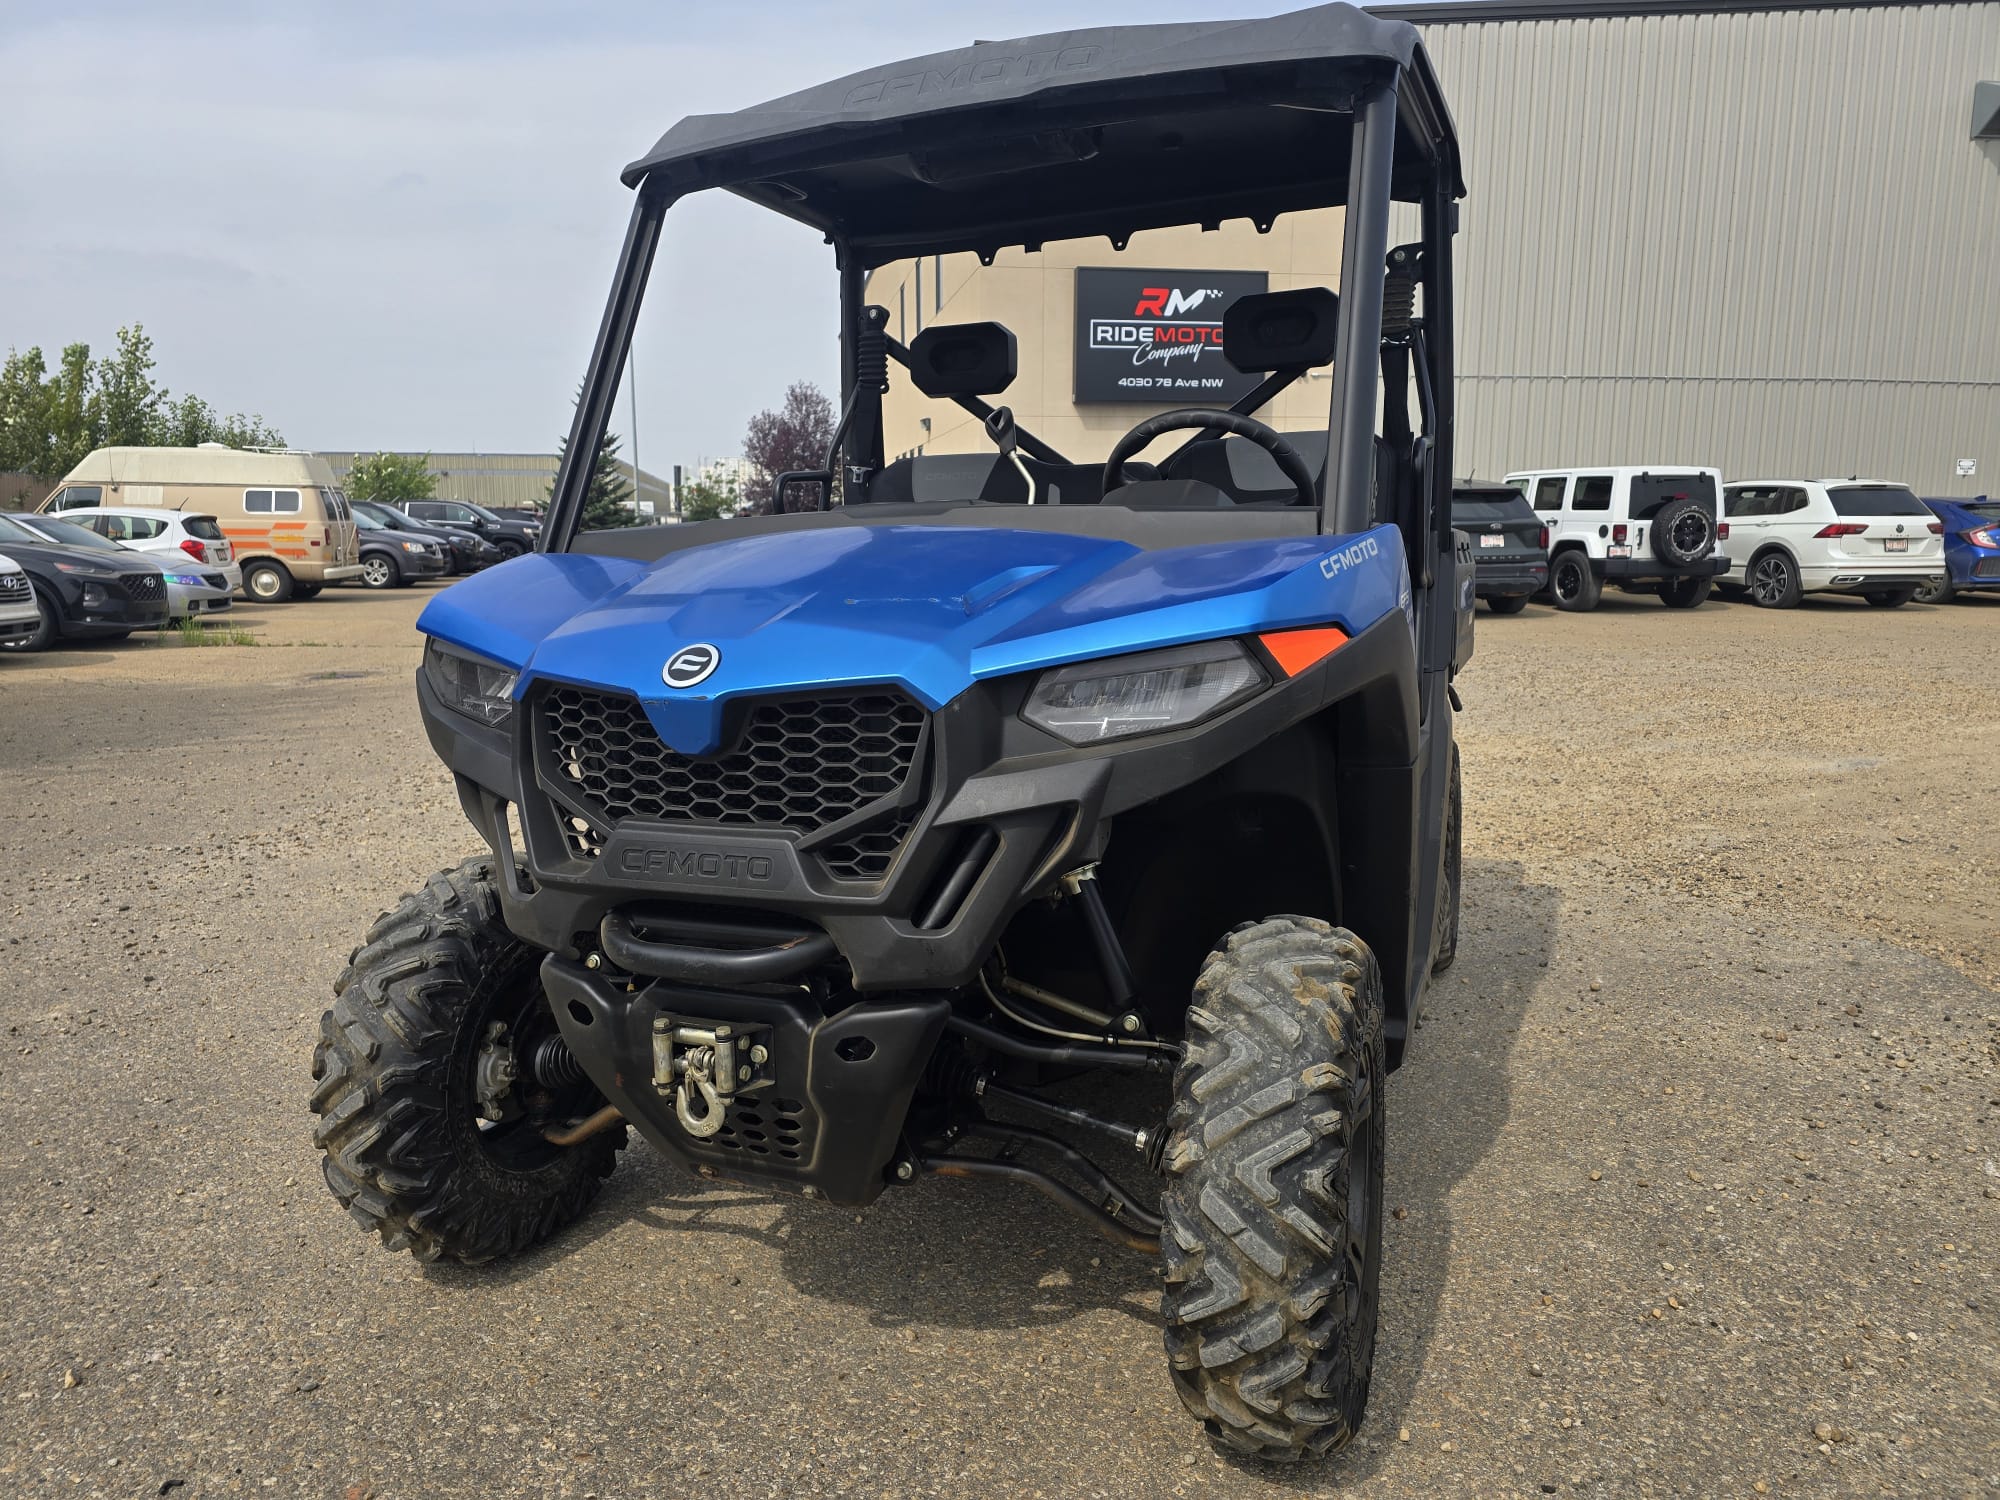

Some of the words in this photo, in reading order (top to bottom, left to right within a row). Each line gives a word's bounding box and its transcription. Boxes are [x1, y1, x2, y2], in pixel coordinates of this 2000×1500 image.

[841, 45, 1103, 109] CFMOTO
[1135, 288, 1206, 316] RM
[1132, 342, 1204, 367] Company
[1118, 378, 1152, 387] 4030
[1155, 378, 1173, 387] 78
[1175, 378, 1199, 388] Ave
[1201, 378, 1224, 388] NW
[1320, 538, 1378, 579] CFMOTO
[621, 848, 773, 880] CFMOTO
